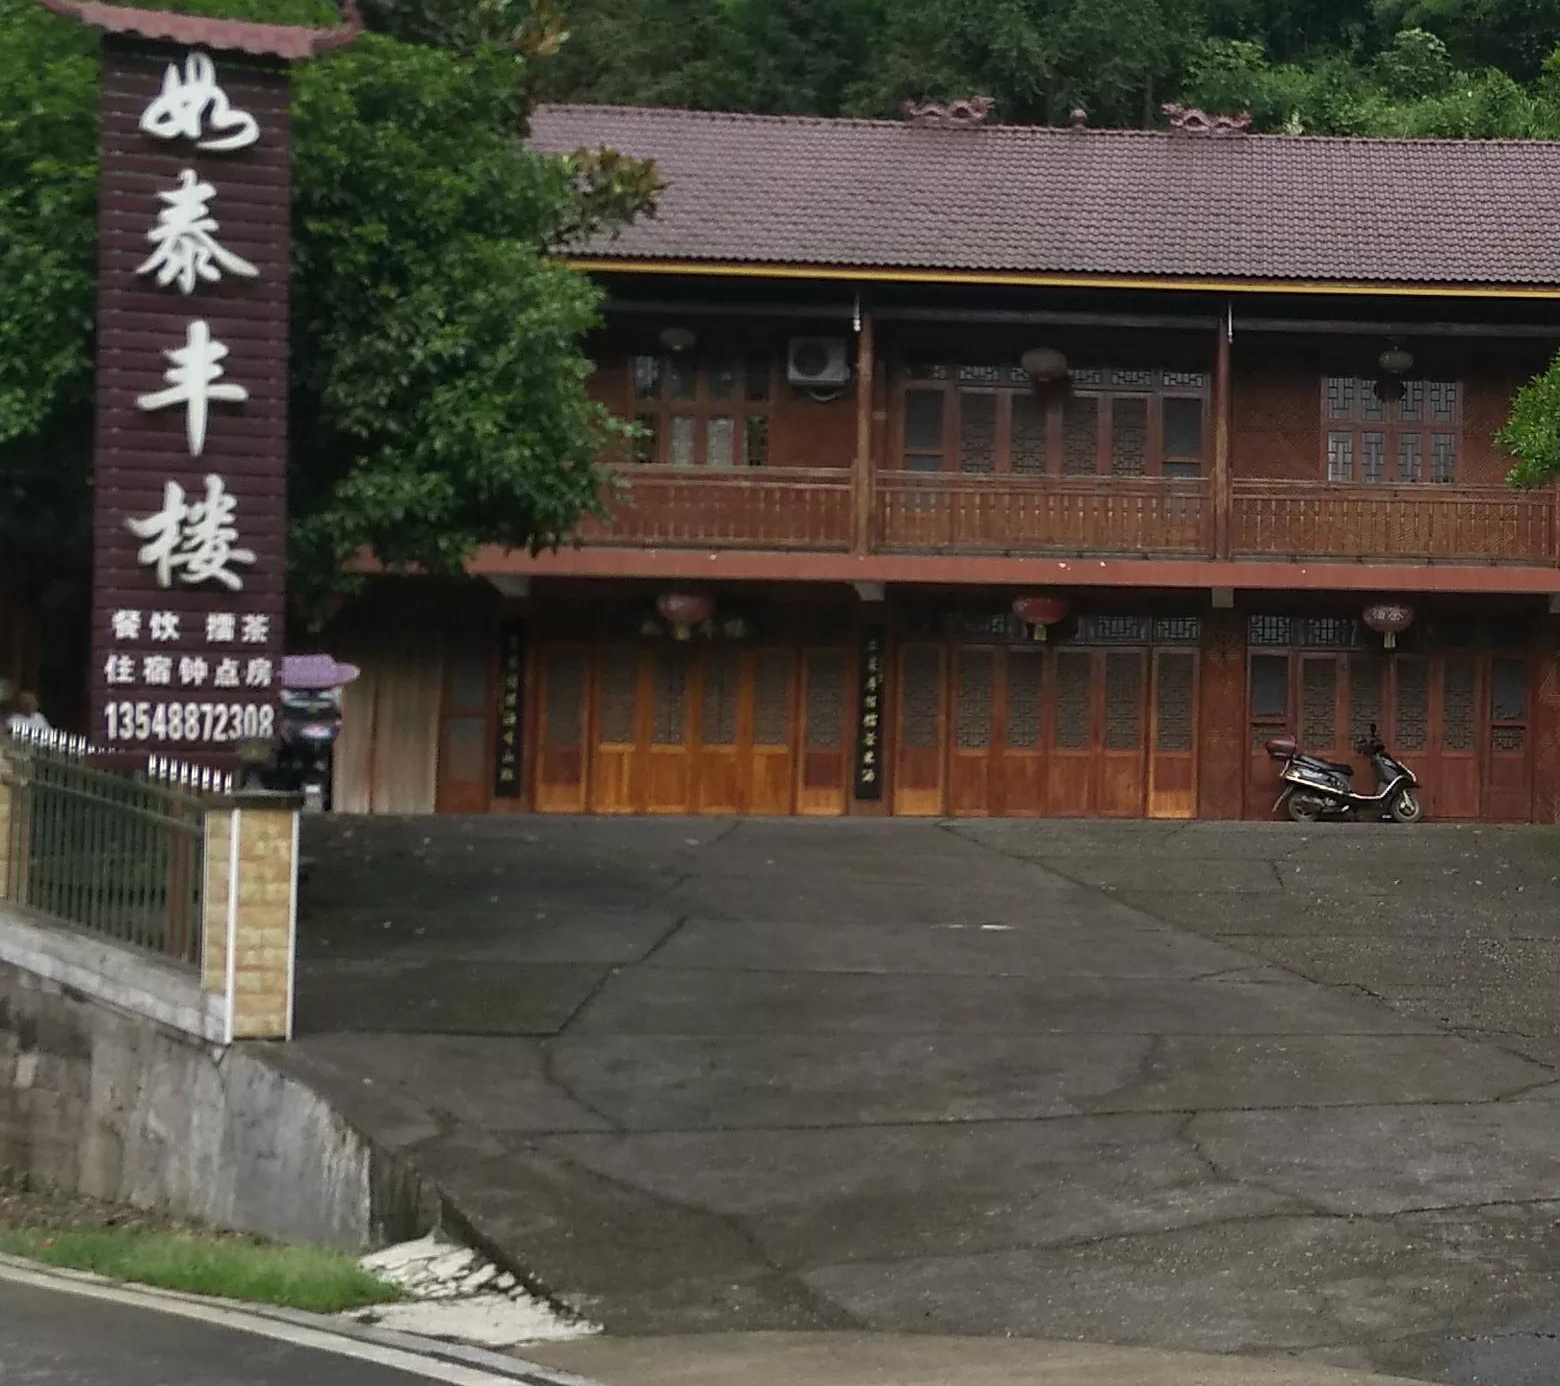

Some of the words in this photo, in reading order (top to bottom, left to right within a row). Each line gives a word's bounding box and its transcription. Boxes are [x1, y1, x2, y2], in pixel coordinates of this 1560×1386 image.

[112, 609, 180, 640] 餐饮
[206, 613, 269, 643] 擂茶
[104, 655, 273, 686] 住宿钟点房
[104, 702, 274, 741] 13548872308
